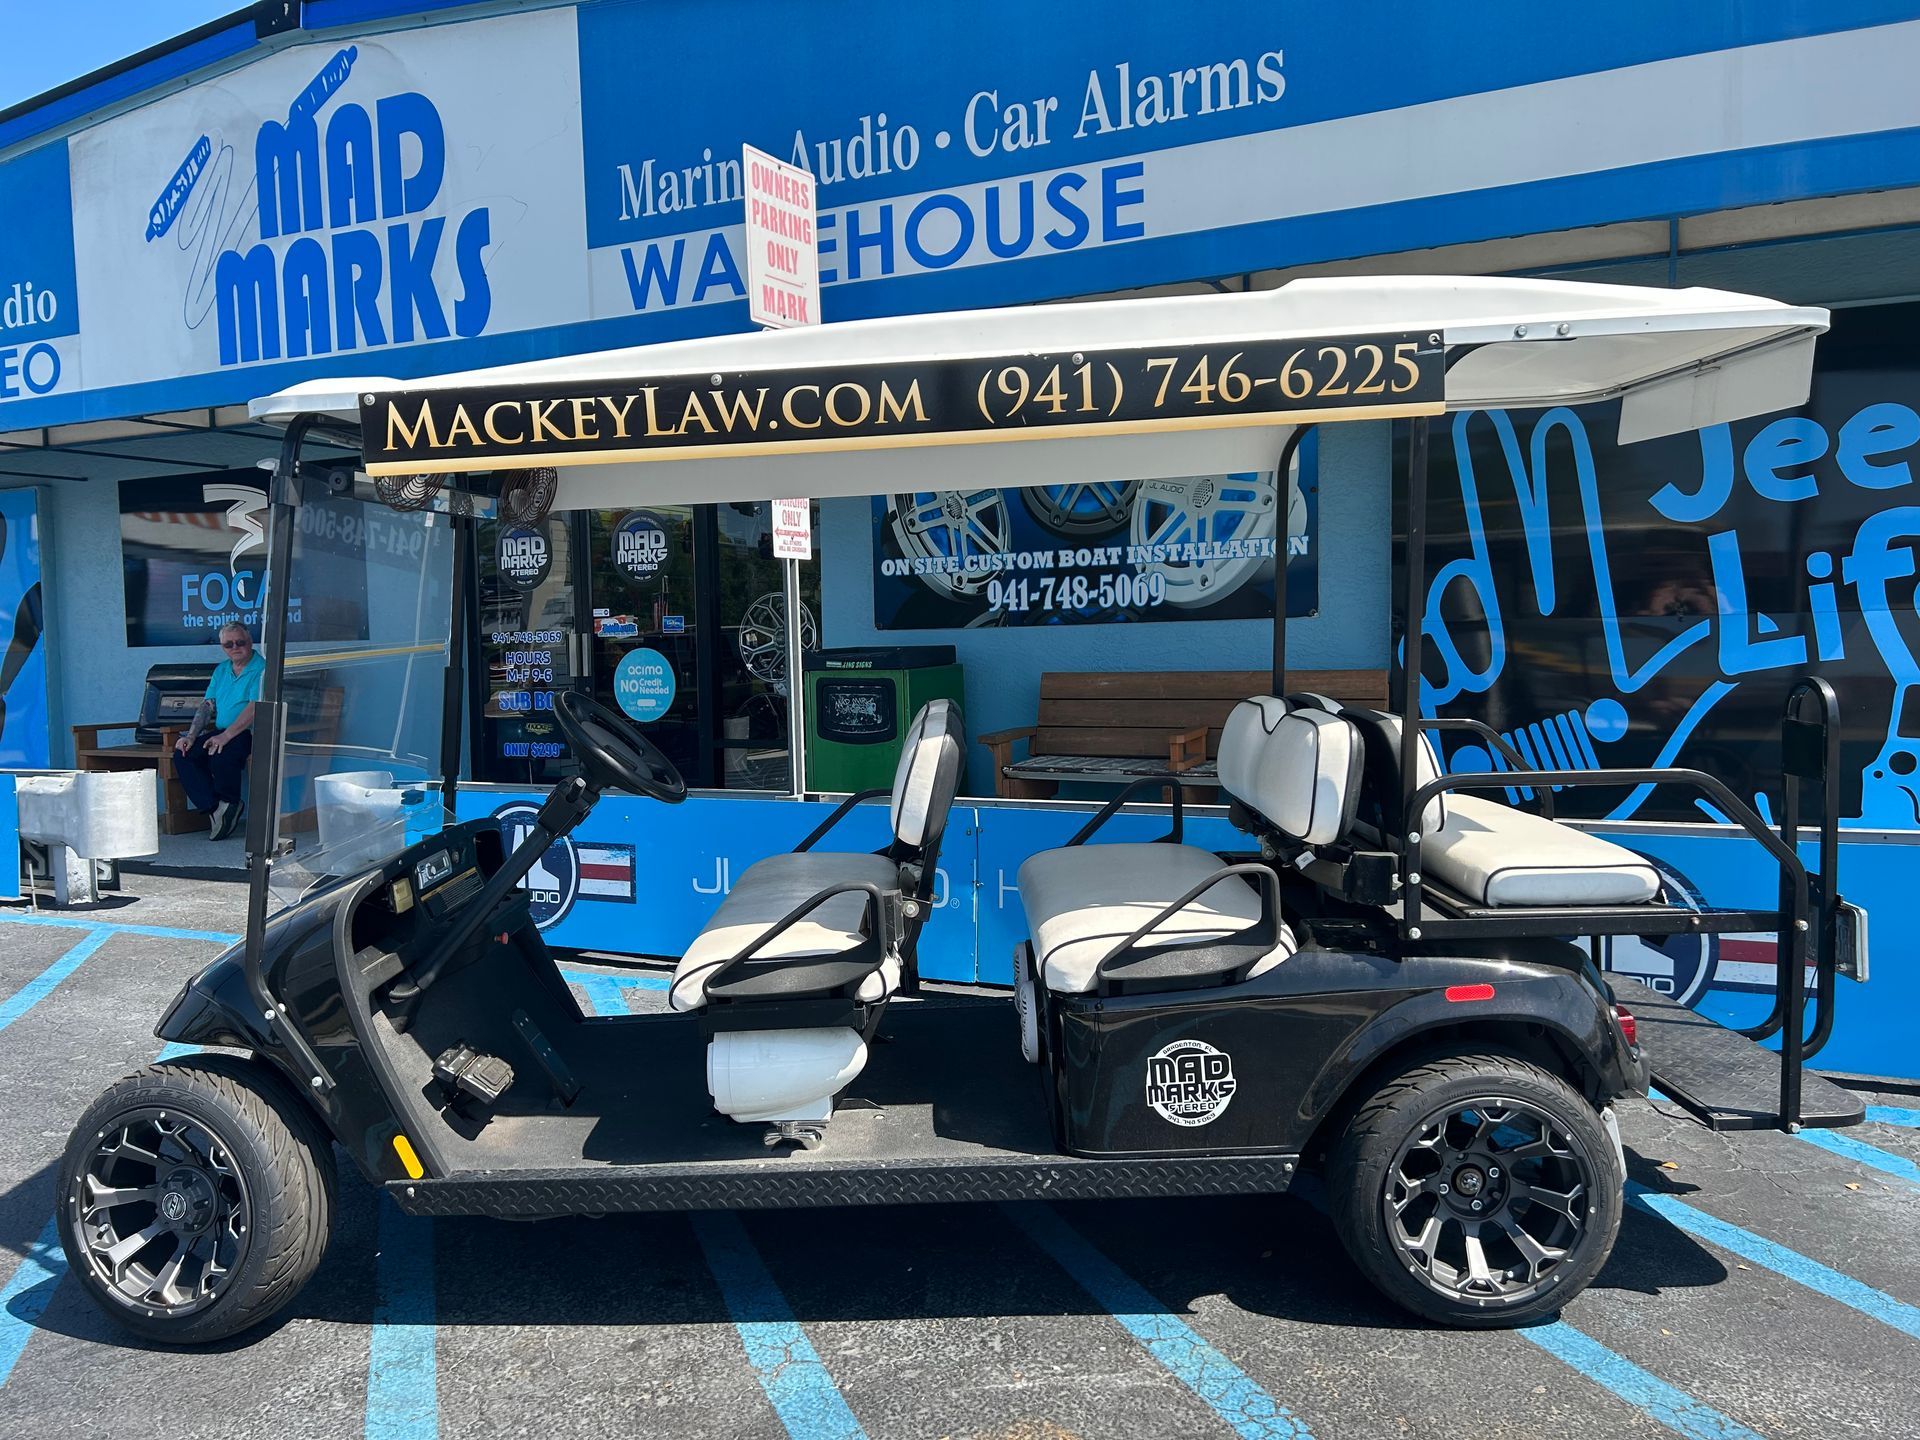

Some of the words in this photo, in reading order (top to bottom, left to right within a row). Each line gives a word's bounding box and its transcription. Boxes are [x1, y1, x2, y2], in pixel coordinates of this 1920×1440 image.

[617, 148, 745, 221] Marin
[964, 88, 1058, 157] Car
[1073, 49, 1286, 138] Alarms
[255, 92, 446, 240] MAD
[751, 161, 809, 210] OWNERS
[752, 198, 812, 246] PARKING
[620, 160, 1145, 311] WAEHOUSE
[767, 240, 799, 275] ONLY
[215, 207, 492, 367] MARKS
[0, 280, 57, 330] dio
[762, 284, 809, 324] MARK
[977, 361, 1124, 425] (941)
[1146, 342, 1420, 408] 746-6225
[782, 509, 802, 527] ONLY
[502, 536, 546, 556] MAD
[618, 530, 666, 550] MAD
[501, 554, 548, 570] MARKS
[617, 548, 668, 565] MARKS
[881, 558, 910, 576] ON
[914, 556, 960, 575] SITE
[963, 551, 1054, 573] CUSTOM
[1058, 547, 1122, 568] BOAT
[1126, 536, 1310, 564] INSTALLATIN
[510, 568, 539, 577] STEREO
[627, 563, 659, 571] STEREO
[986, 571, 1167, 612] 941-748-5069
[1707, 506, 1920, 677] Lif
[183, 613, 204, 628] the
[207, 612, 240, 630] spirit
[243, 610, 258, 625] of
[491, 631, 562, 644] 941-748-5069
[505, 651, 551, 665] HOURS
[506, 669, 531, 683] M-F
[532, 669, 553, 682] 9-6
[627, 665, 663, 675] acima
[620, 679, 639, 693] NO
[639, 677, 663, 687] Credit
[639, 686, 669, 695] Needed
[498, 691, 532, 711] SUB
[534, 691, 555, 711] BO
[503, 743, 530, 757] ONLY
[1149, 1053, 1231, 1085] MAD
[1147, 1080, 1235, 1106] MARKS
[1168, 1102, 1216, 1113] STEREO
